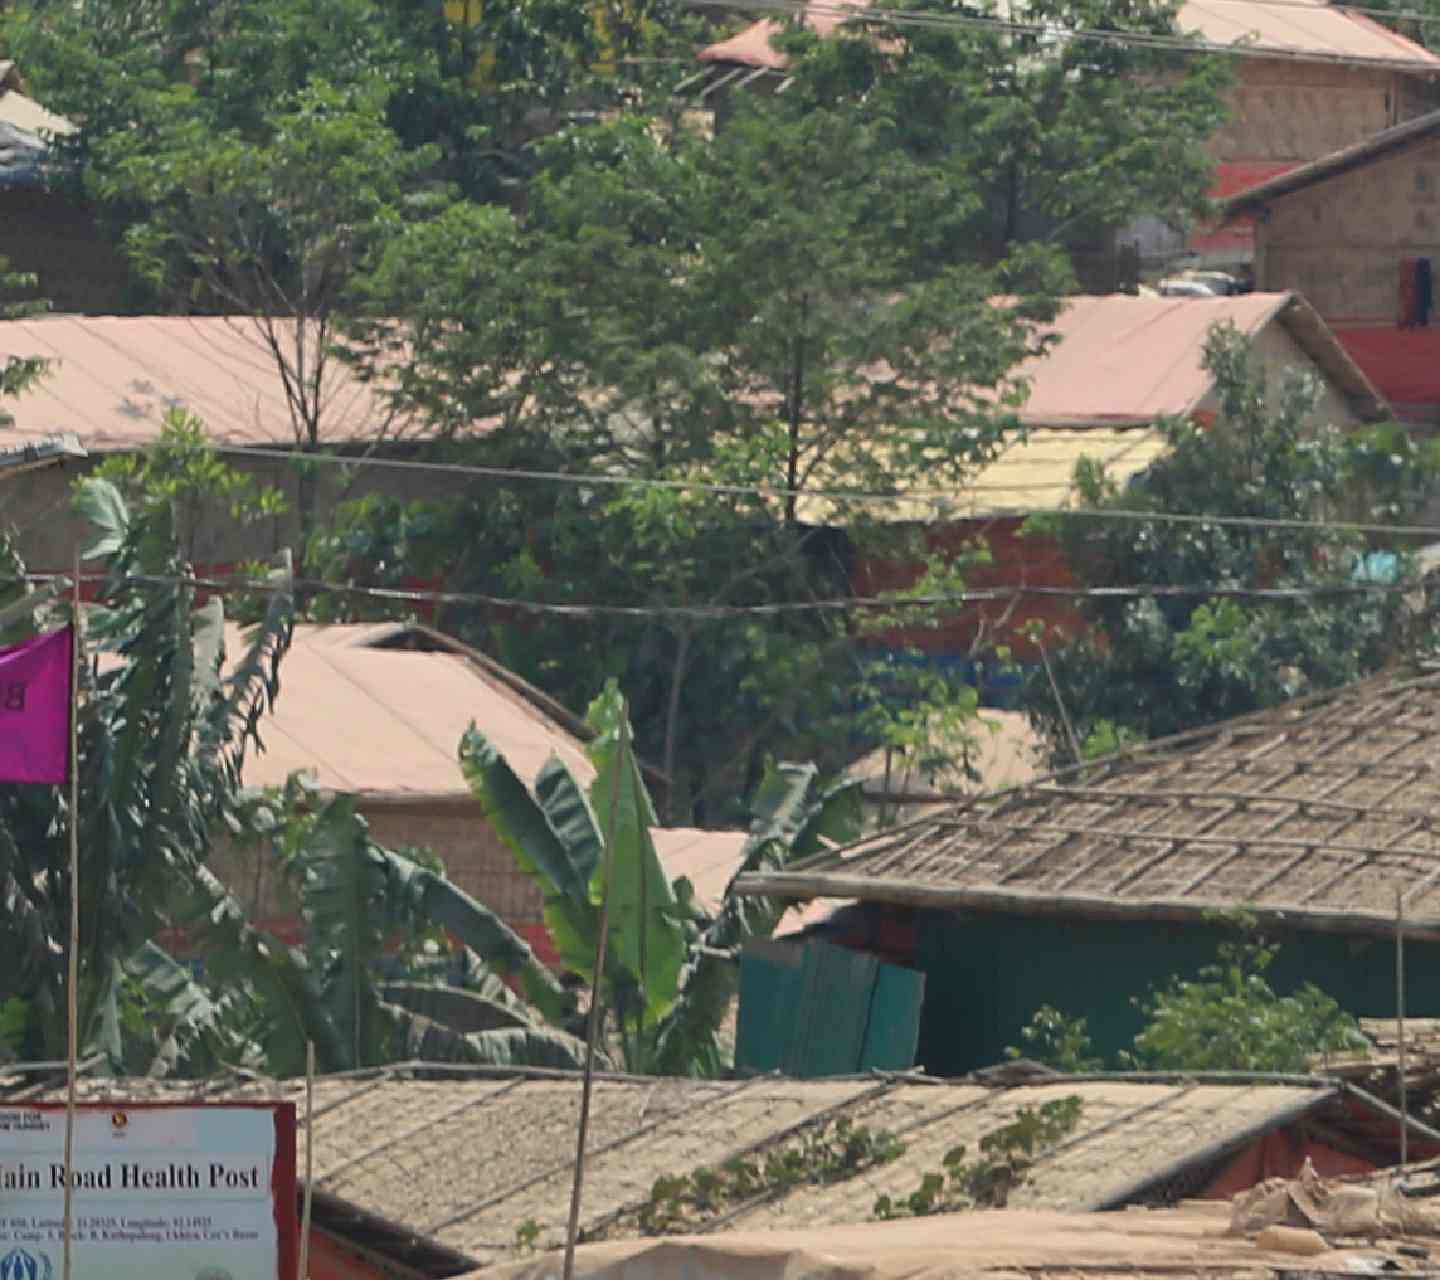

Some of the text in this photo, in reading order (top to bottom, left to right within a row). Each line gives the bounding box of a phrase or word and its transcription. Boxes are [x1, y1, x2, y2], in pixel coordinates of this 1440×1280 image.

[50, 1163, 111, 1189] Road
[121, 1163, 200, 1189] Health
[209, 1163, 260, 1189] Post
